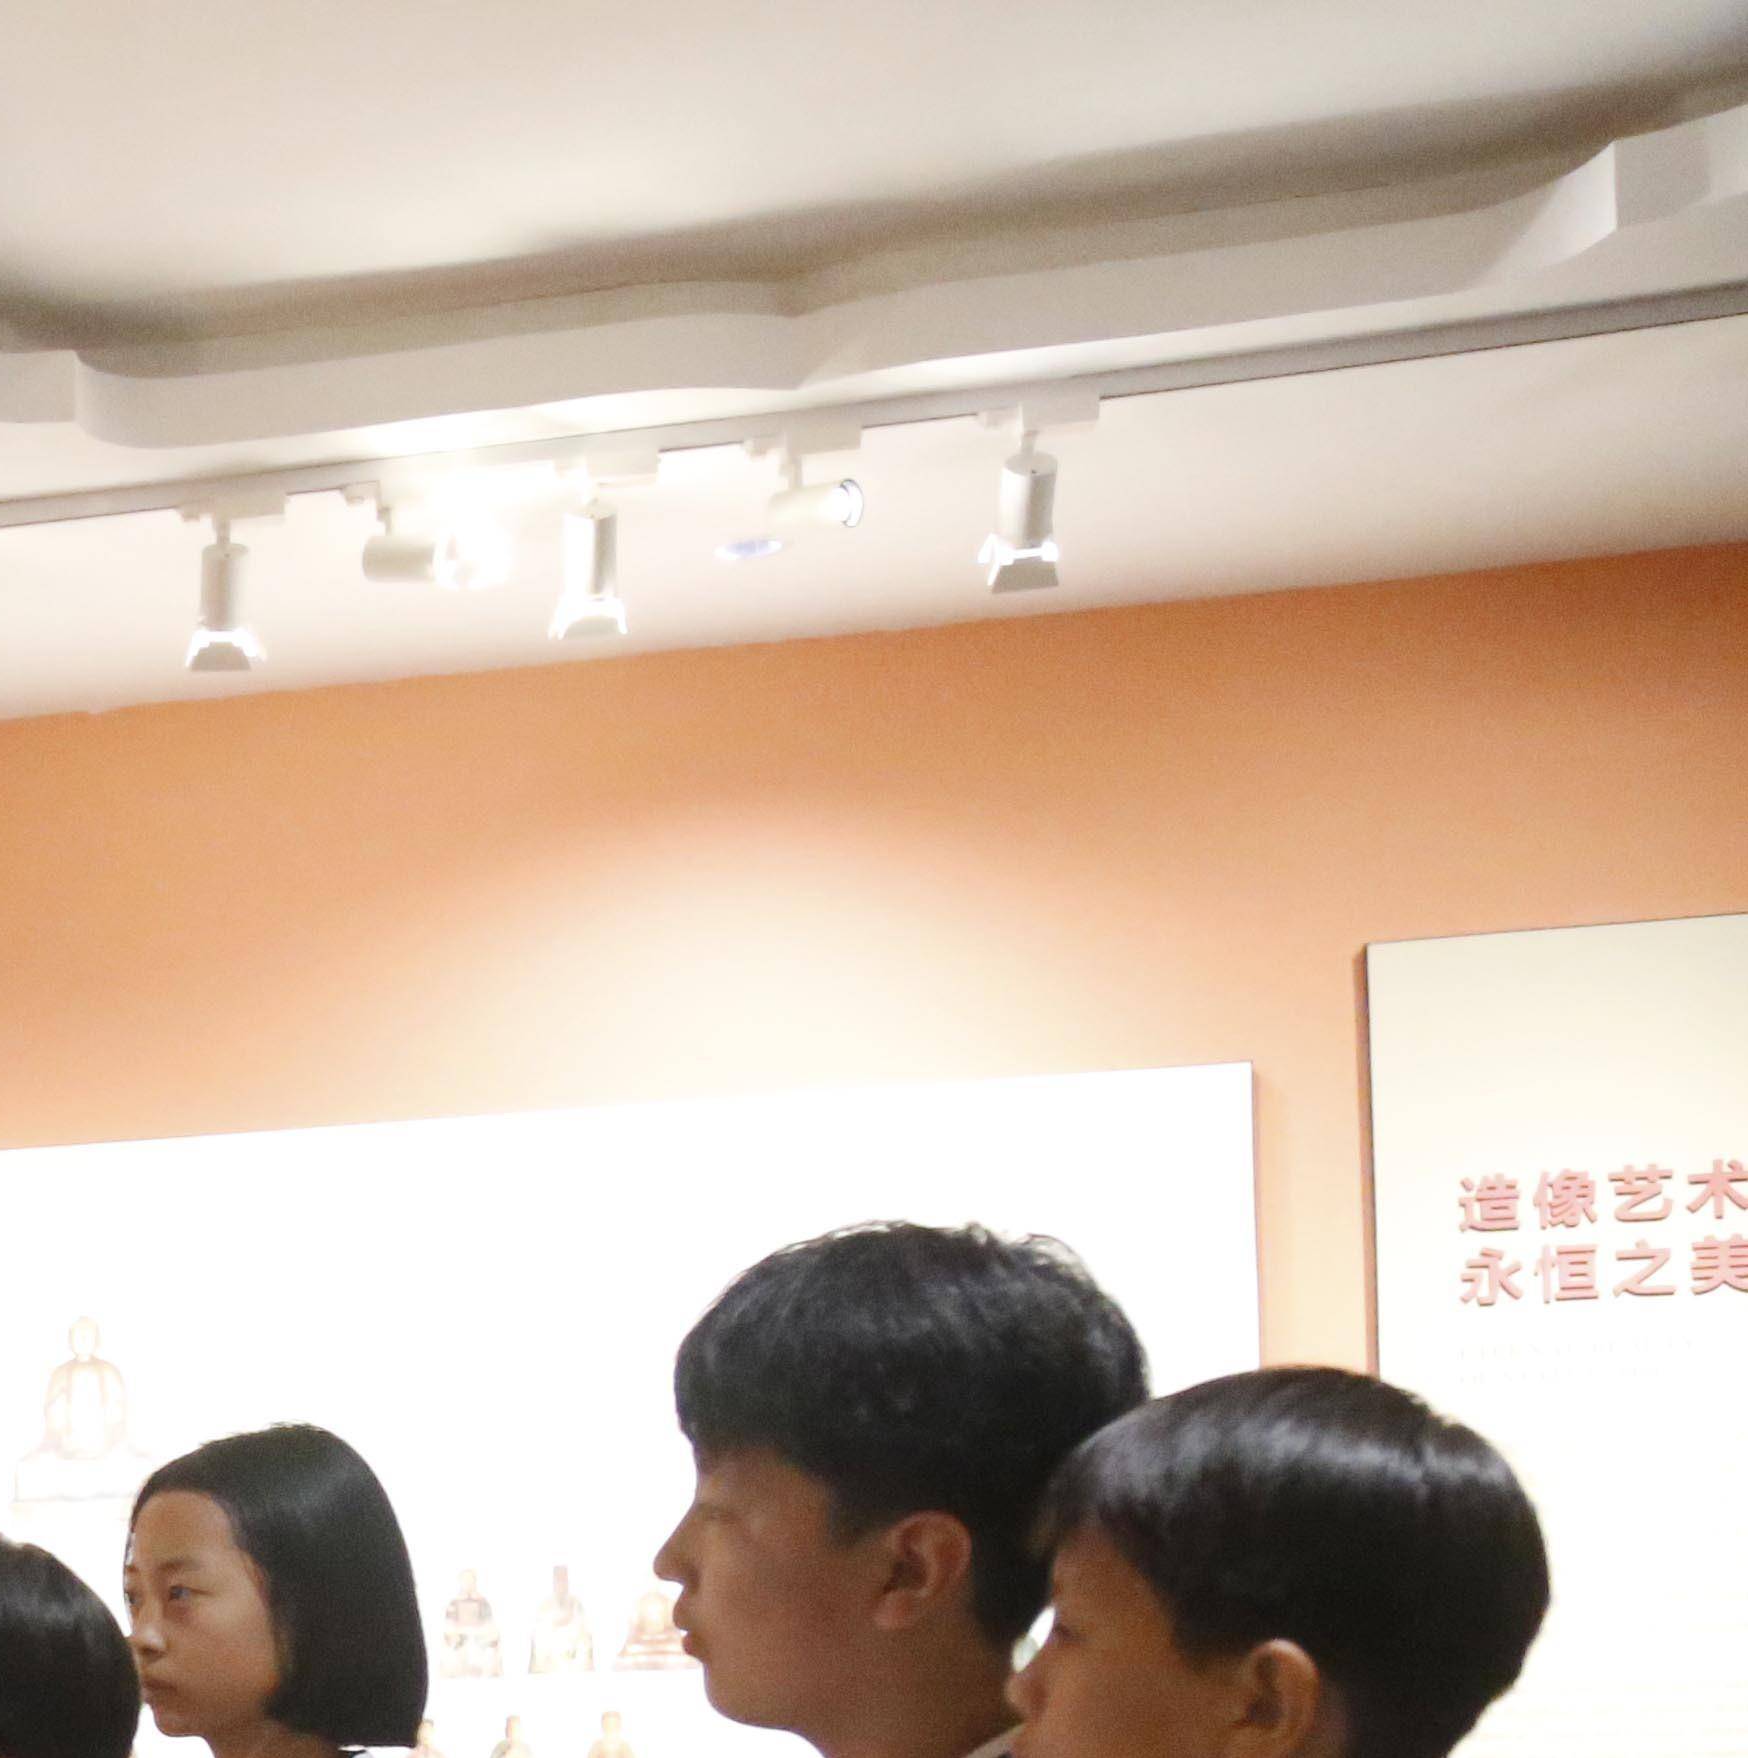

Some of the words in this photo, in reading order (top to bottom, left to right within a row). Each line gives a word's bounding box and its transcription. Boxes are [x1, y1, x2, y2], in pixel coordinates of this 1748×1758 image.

[1458, 1158, 1748, 1233] 造像艺术
[1459, 1233, 1748, 1307] 永恒之美
